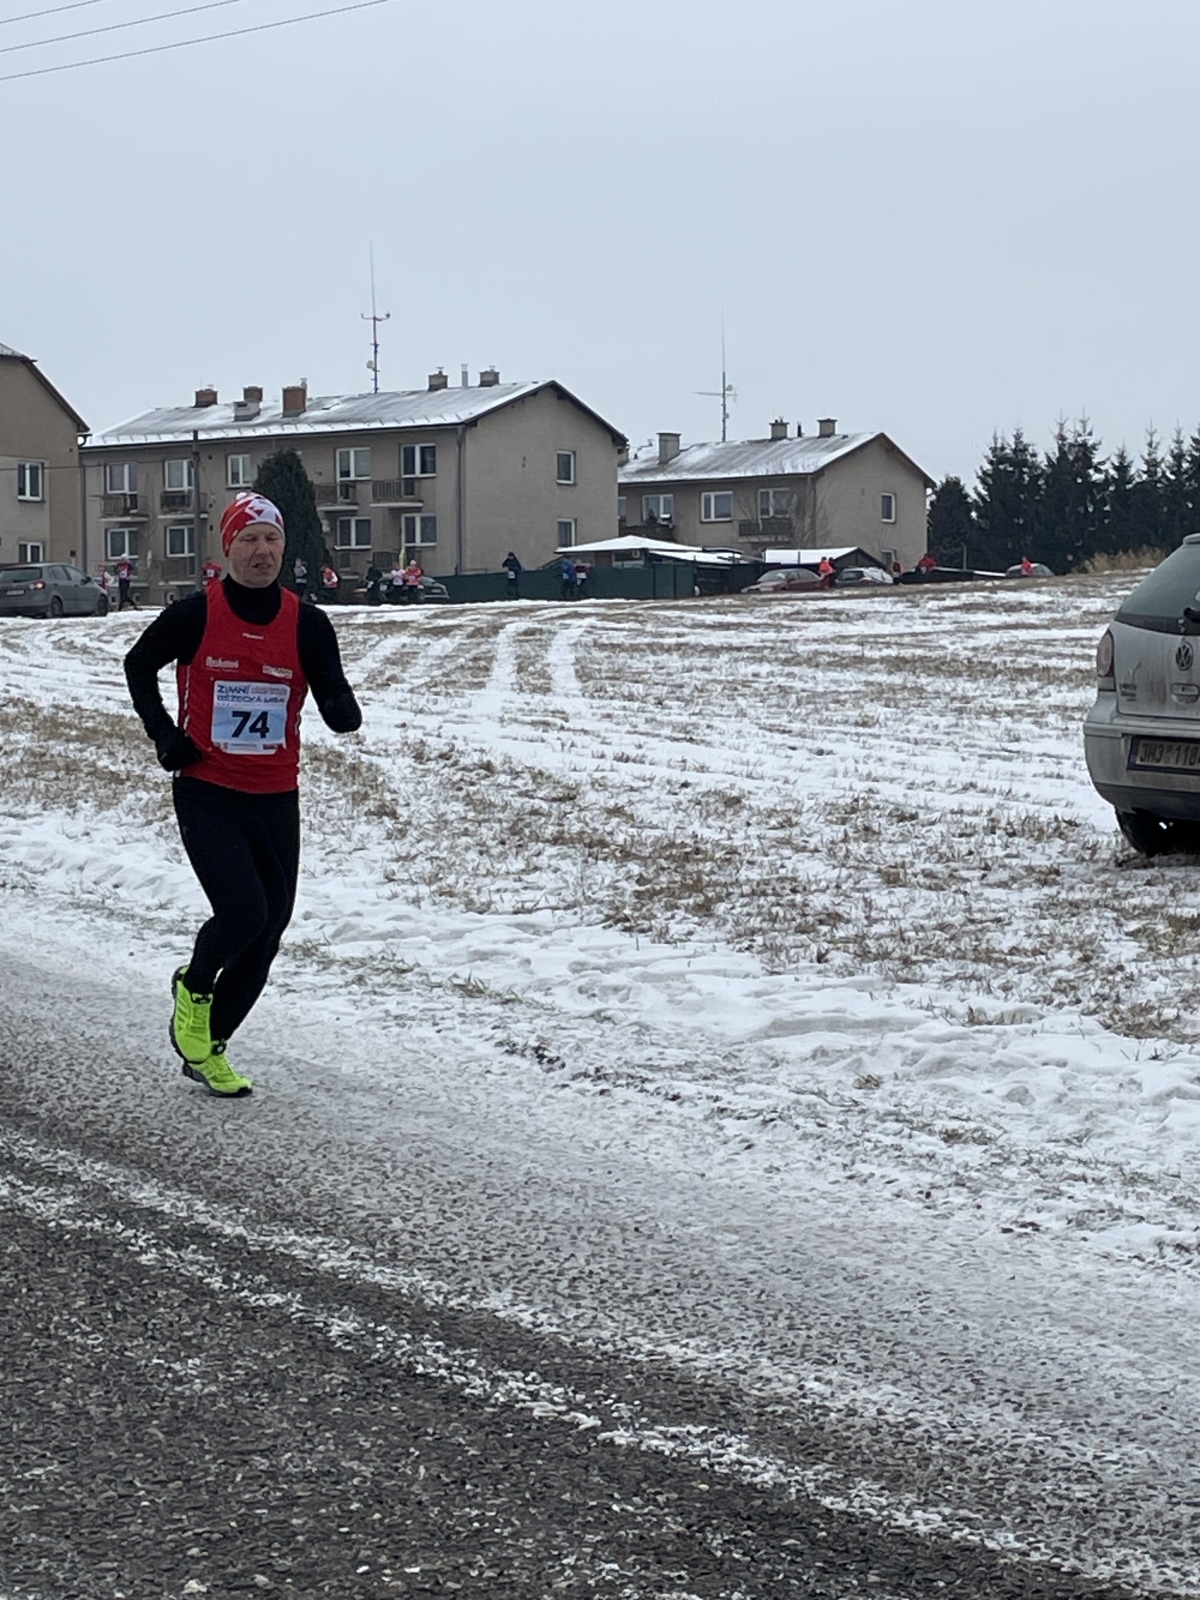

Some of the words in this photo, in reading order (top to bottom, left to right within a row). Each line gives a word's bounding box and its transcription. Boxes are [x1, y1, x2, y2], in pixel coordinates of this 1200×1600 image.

[231, 711, 270, 739] 74
[1139, 743, 1164, 763] 3H3
[1175, 745, 1200, 766] 118
